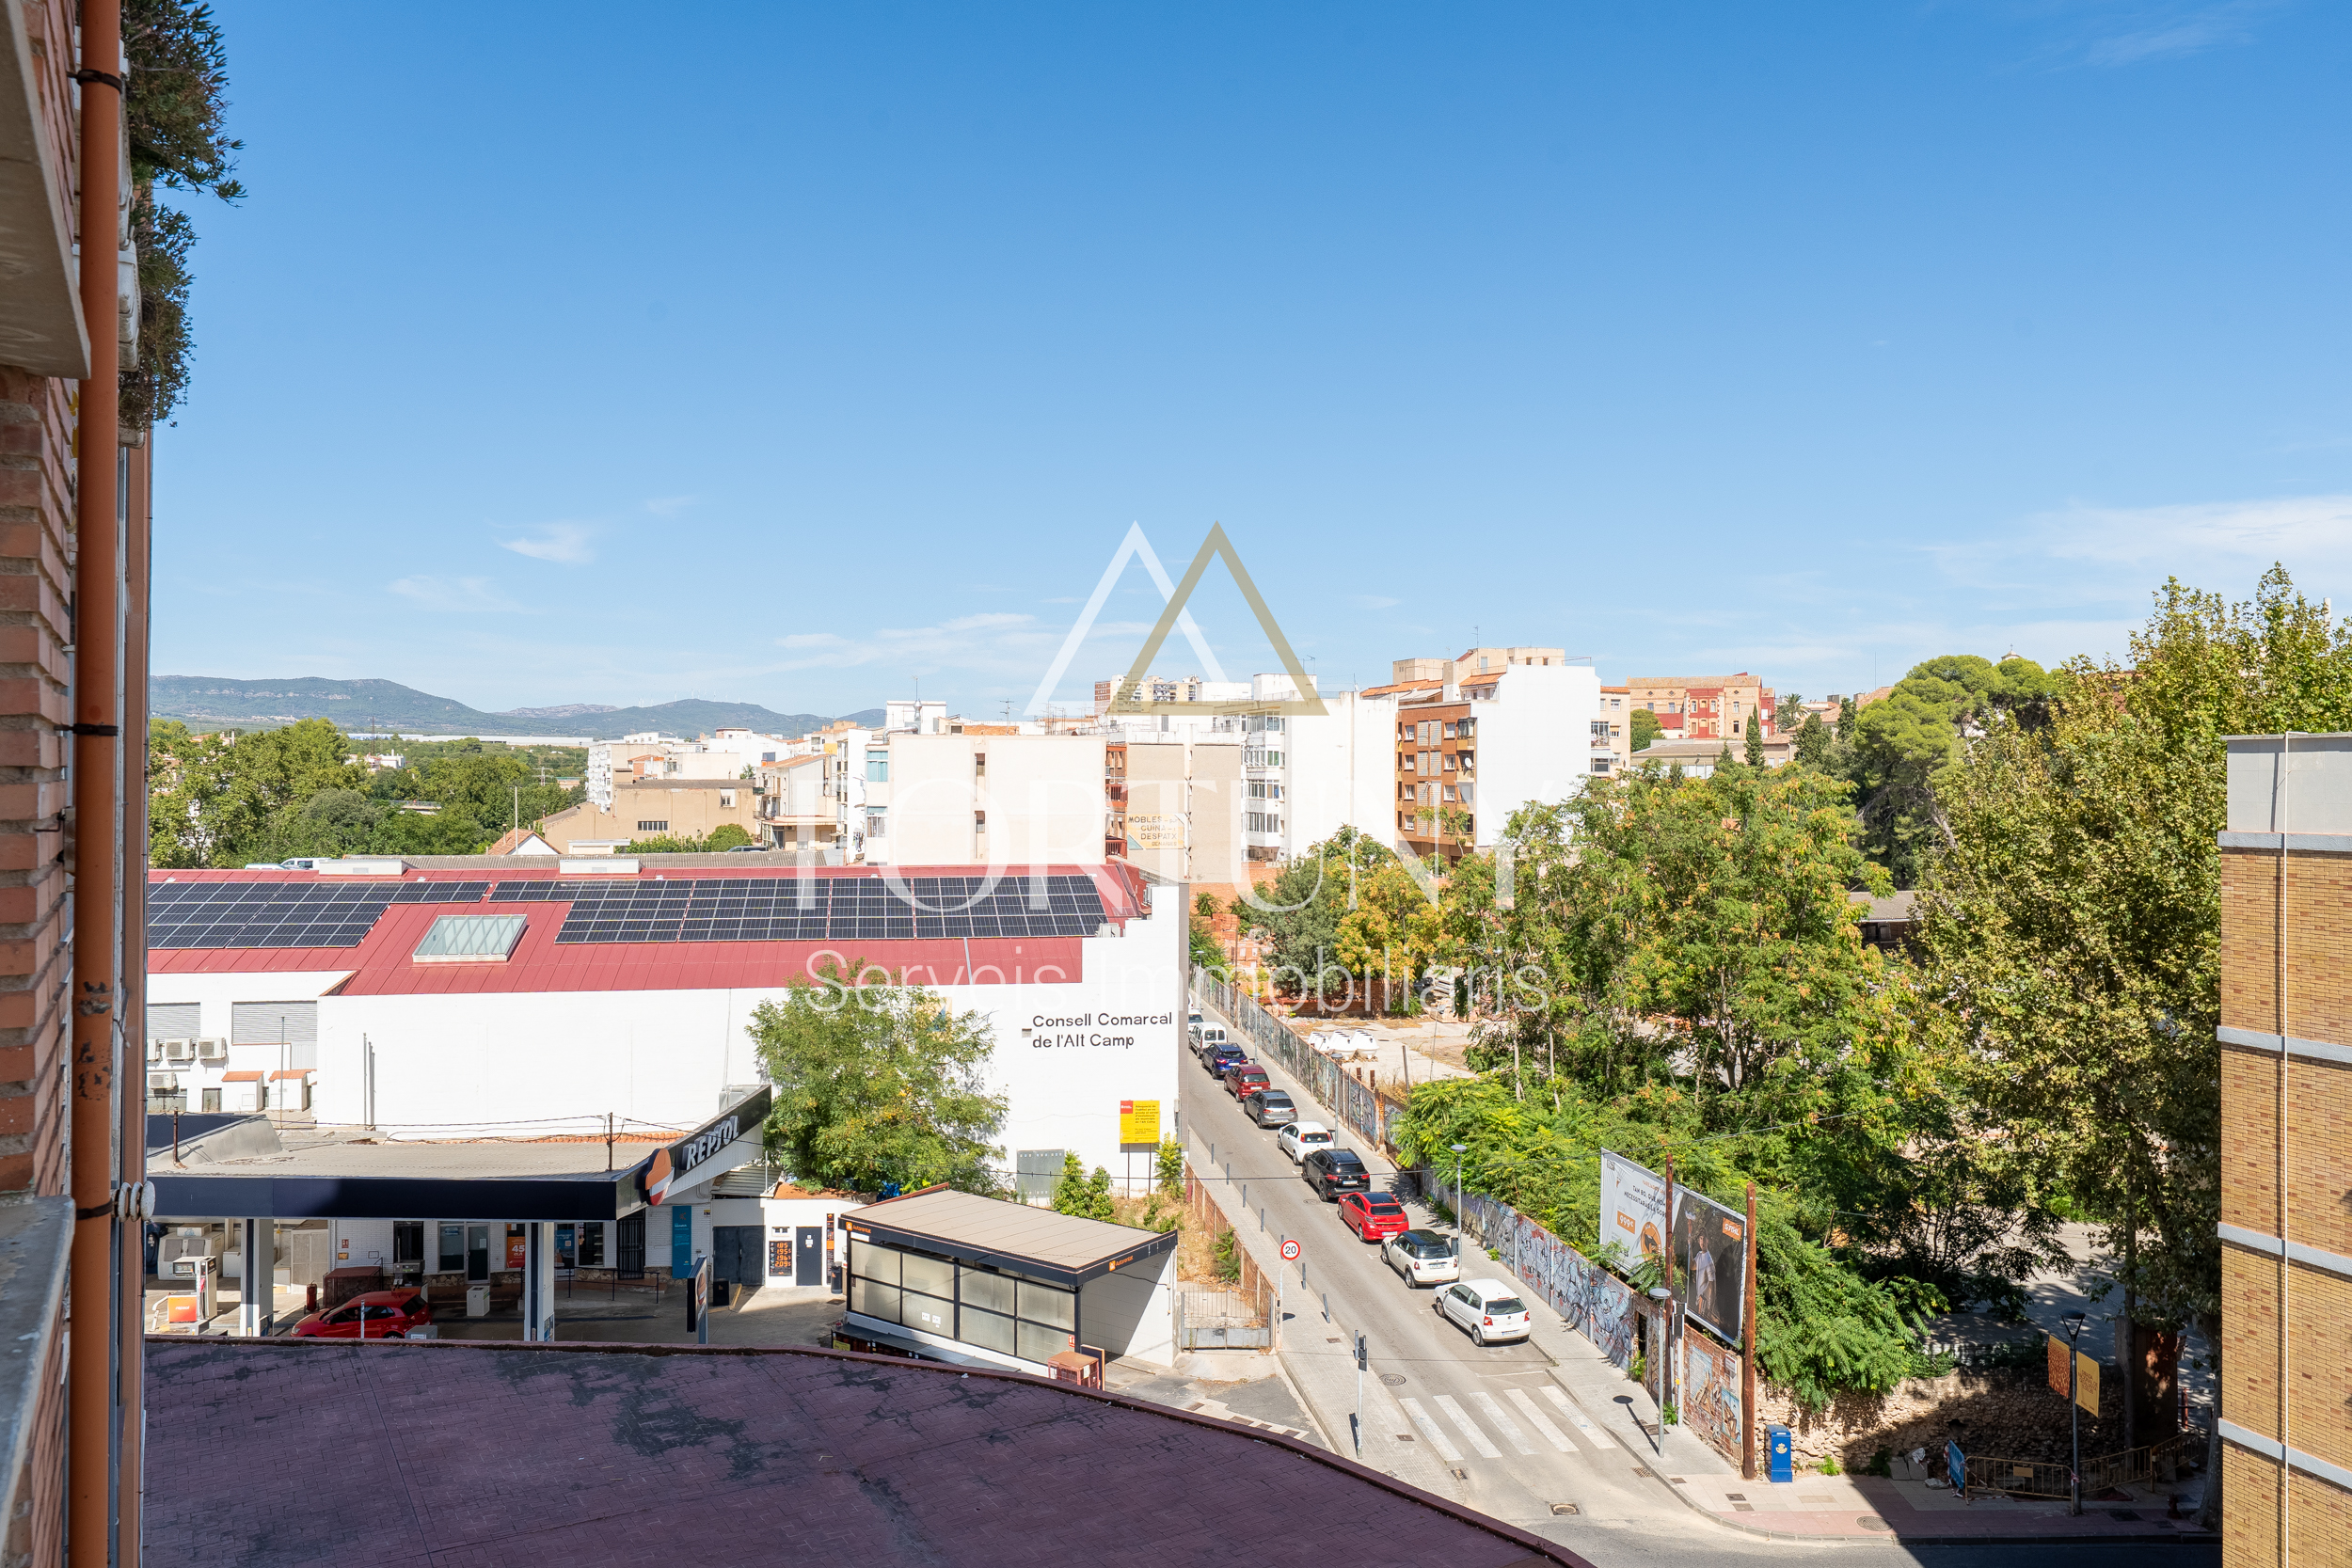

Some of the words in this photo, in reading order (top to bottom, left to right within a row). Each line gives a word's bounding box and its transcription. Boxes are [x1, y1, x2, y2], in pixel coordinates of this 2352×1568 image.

[1032, 1013, 1091, 1027] Consell
[1098, 1012, 1172, 1026] Comarcal
[1032, 1035, 1052, 1048] de
[1057, 1034, 1085, 1048] l'Alt
[1089, 1034, 1135, 1049] Camp
[685, 1116, 739, 1171] REPSOL
[1724, 1223, 1740, 1236] STIHL
[512, 1244, 525, 1253] 45
[1285, 1245, 1296, 1254] 20
